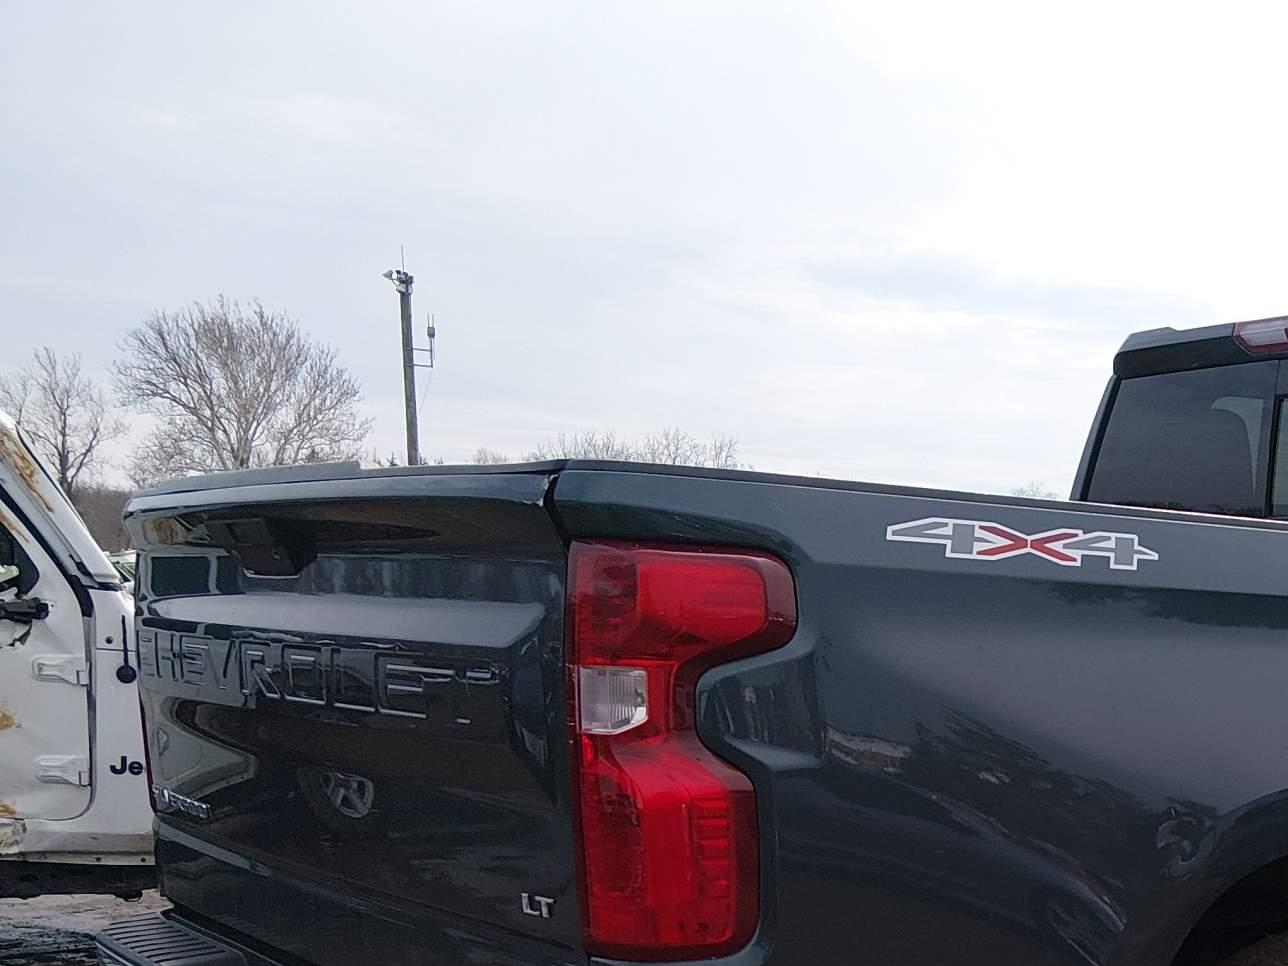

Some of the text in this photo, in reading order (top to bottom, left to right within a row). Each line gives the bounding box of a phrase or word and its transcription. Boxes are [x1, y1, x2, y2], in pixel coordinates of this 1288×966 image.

[886, 517, 1159, 570] 4X4
[109, 755, 144, 776] Je
[520, 892, 555, 919] LT
